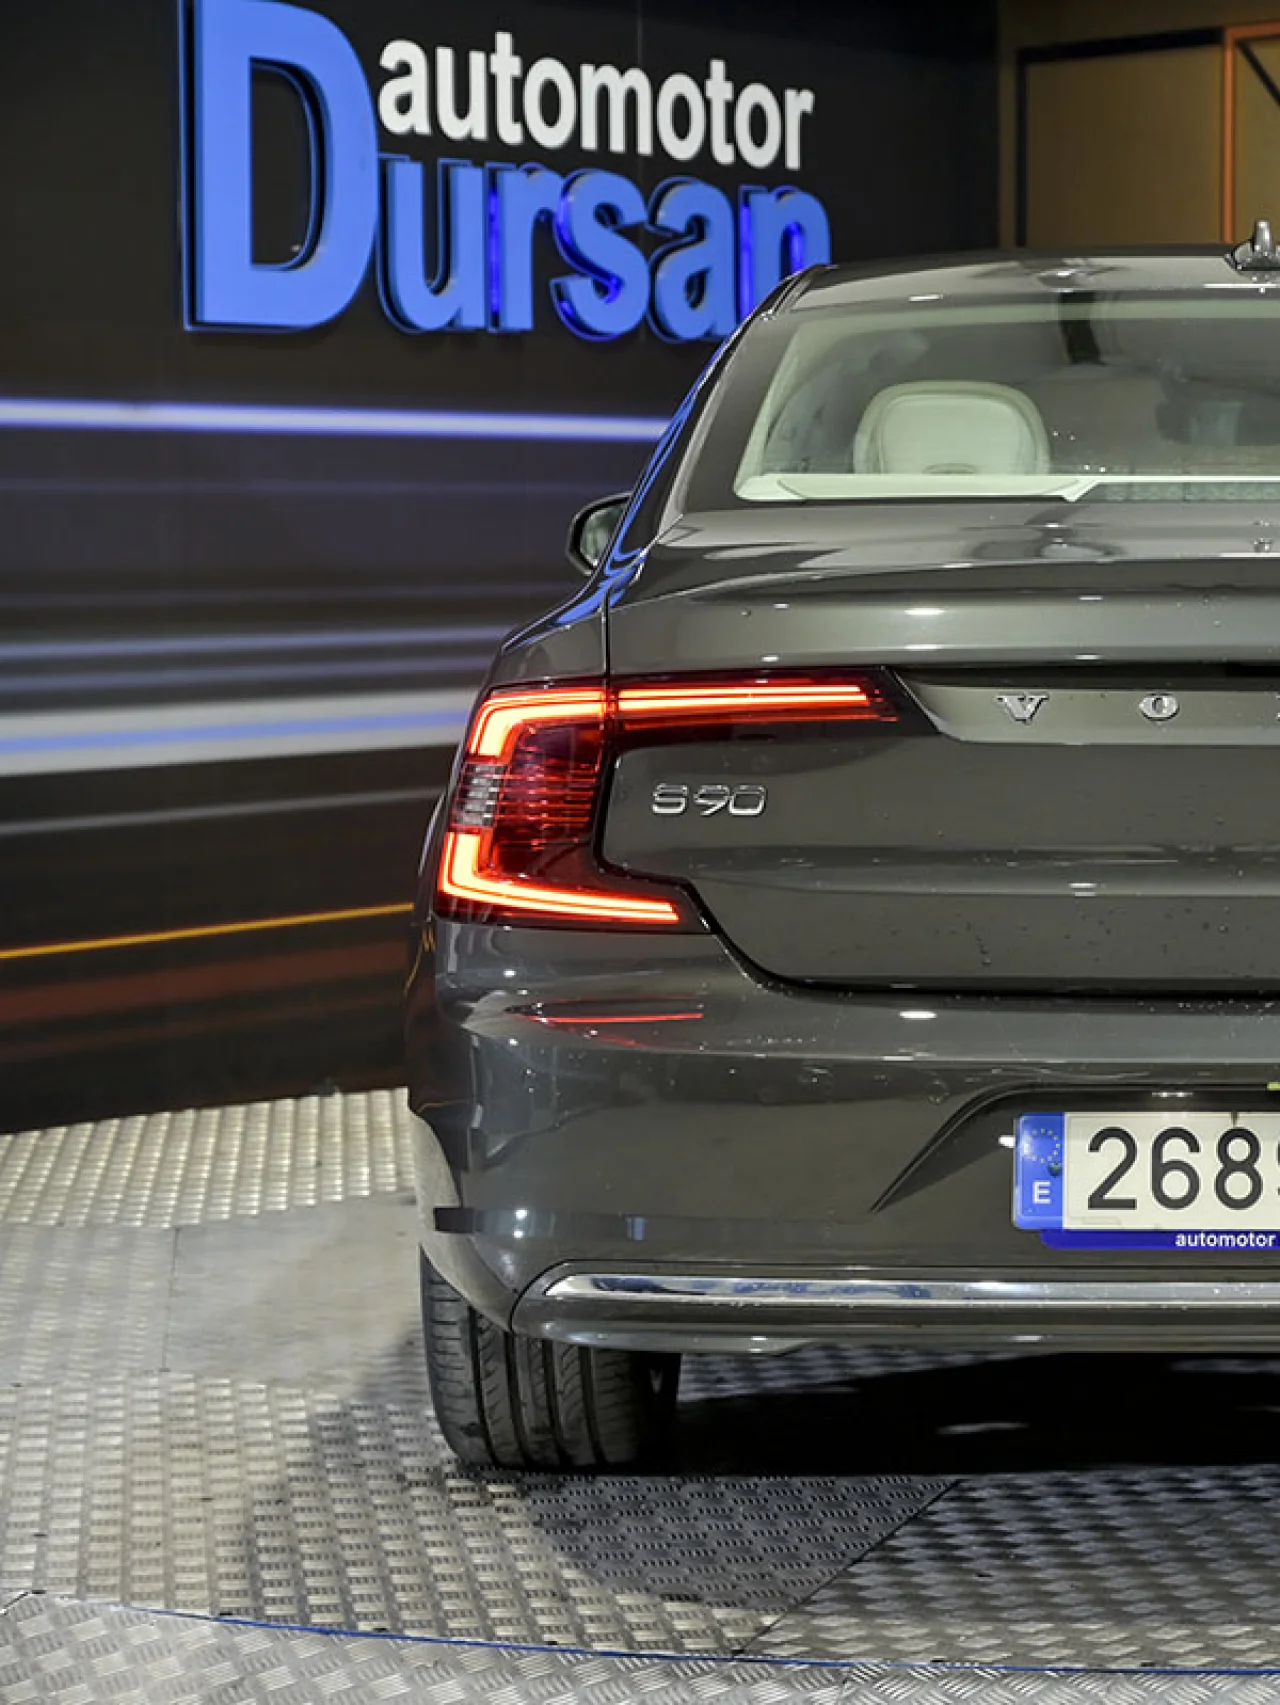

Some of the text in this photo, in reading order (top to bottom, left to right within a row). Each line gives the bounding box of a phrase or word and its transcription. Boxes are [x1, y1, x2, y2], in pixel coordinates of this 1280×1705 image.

[377, 31, 814, 169] automotor
[179, 0, 831, 342] Dursan
[652, 783, 766, 815] S90
[1033, 1181, 1050, 1204] E
[1175, 1231, 1276, 1248] automotor
